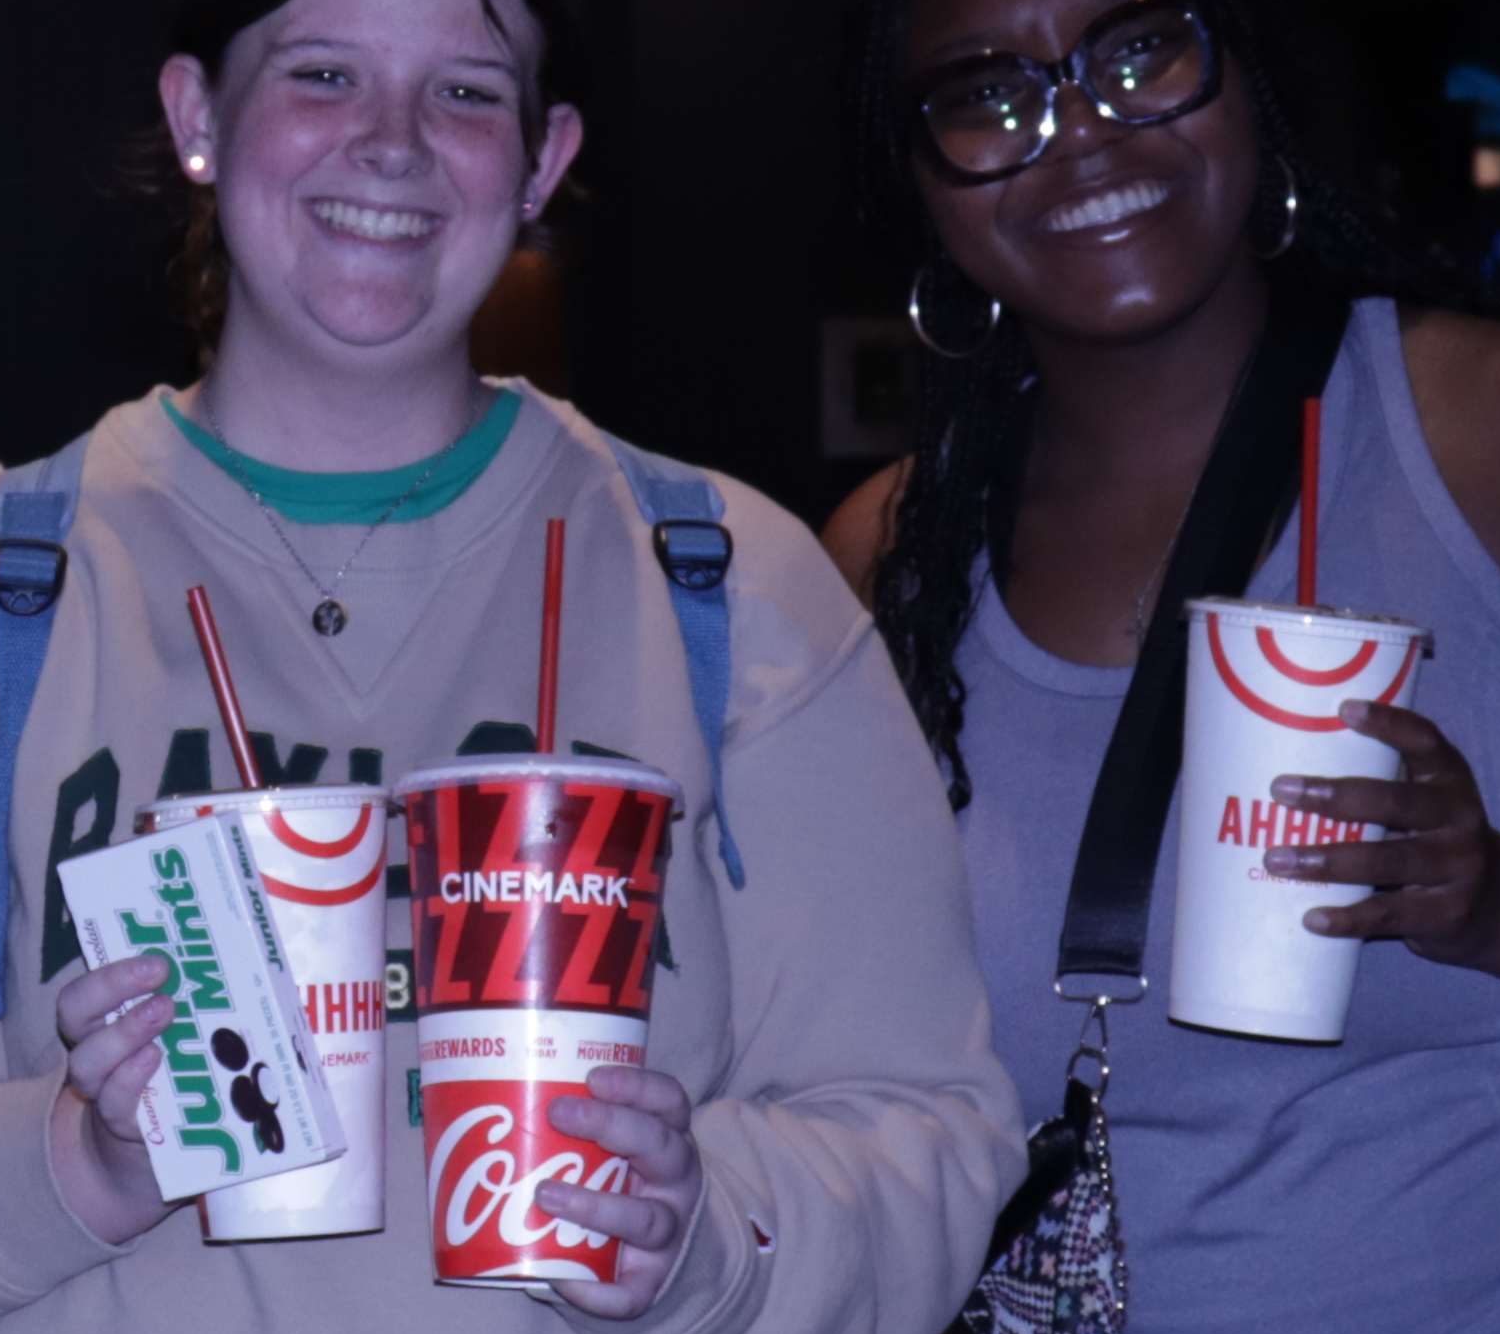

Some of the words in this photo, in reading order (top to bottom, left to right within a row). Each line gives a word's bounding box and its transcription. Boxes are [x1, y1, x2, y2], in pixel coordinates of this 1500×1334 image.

[440, 870, 629, 909] CINEMARK
[153, 845, 233, 1010] Mints
[434, 1037, 507, 1059] REWARDS
